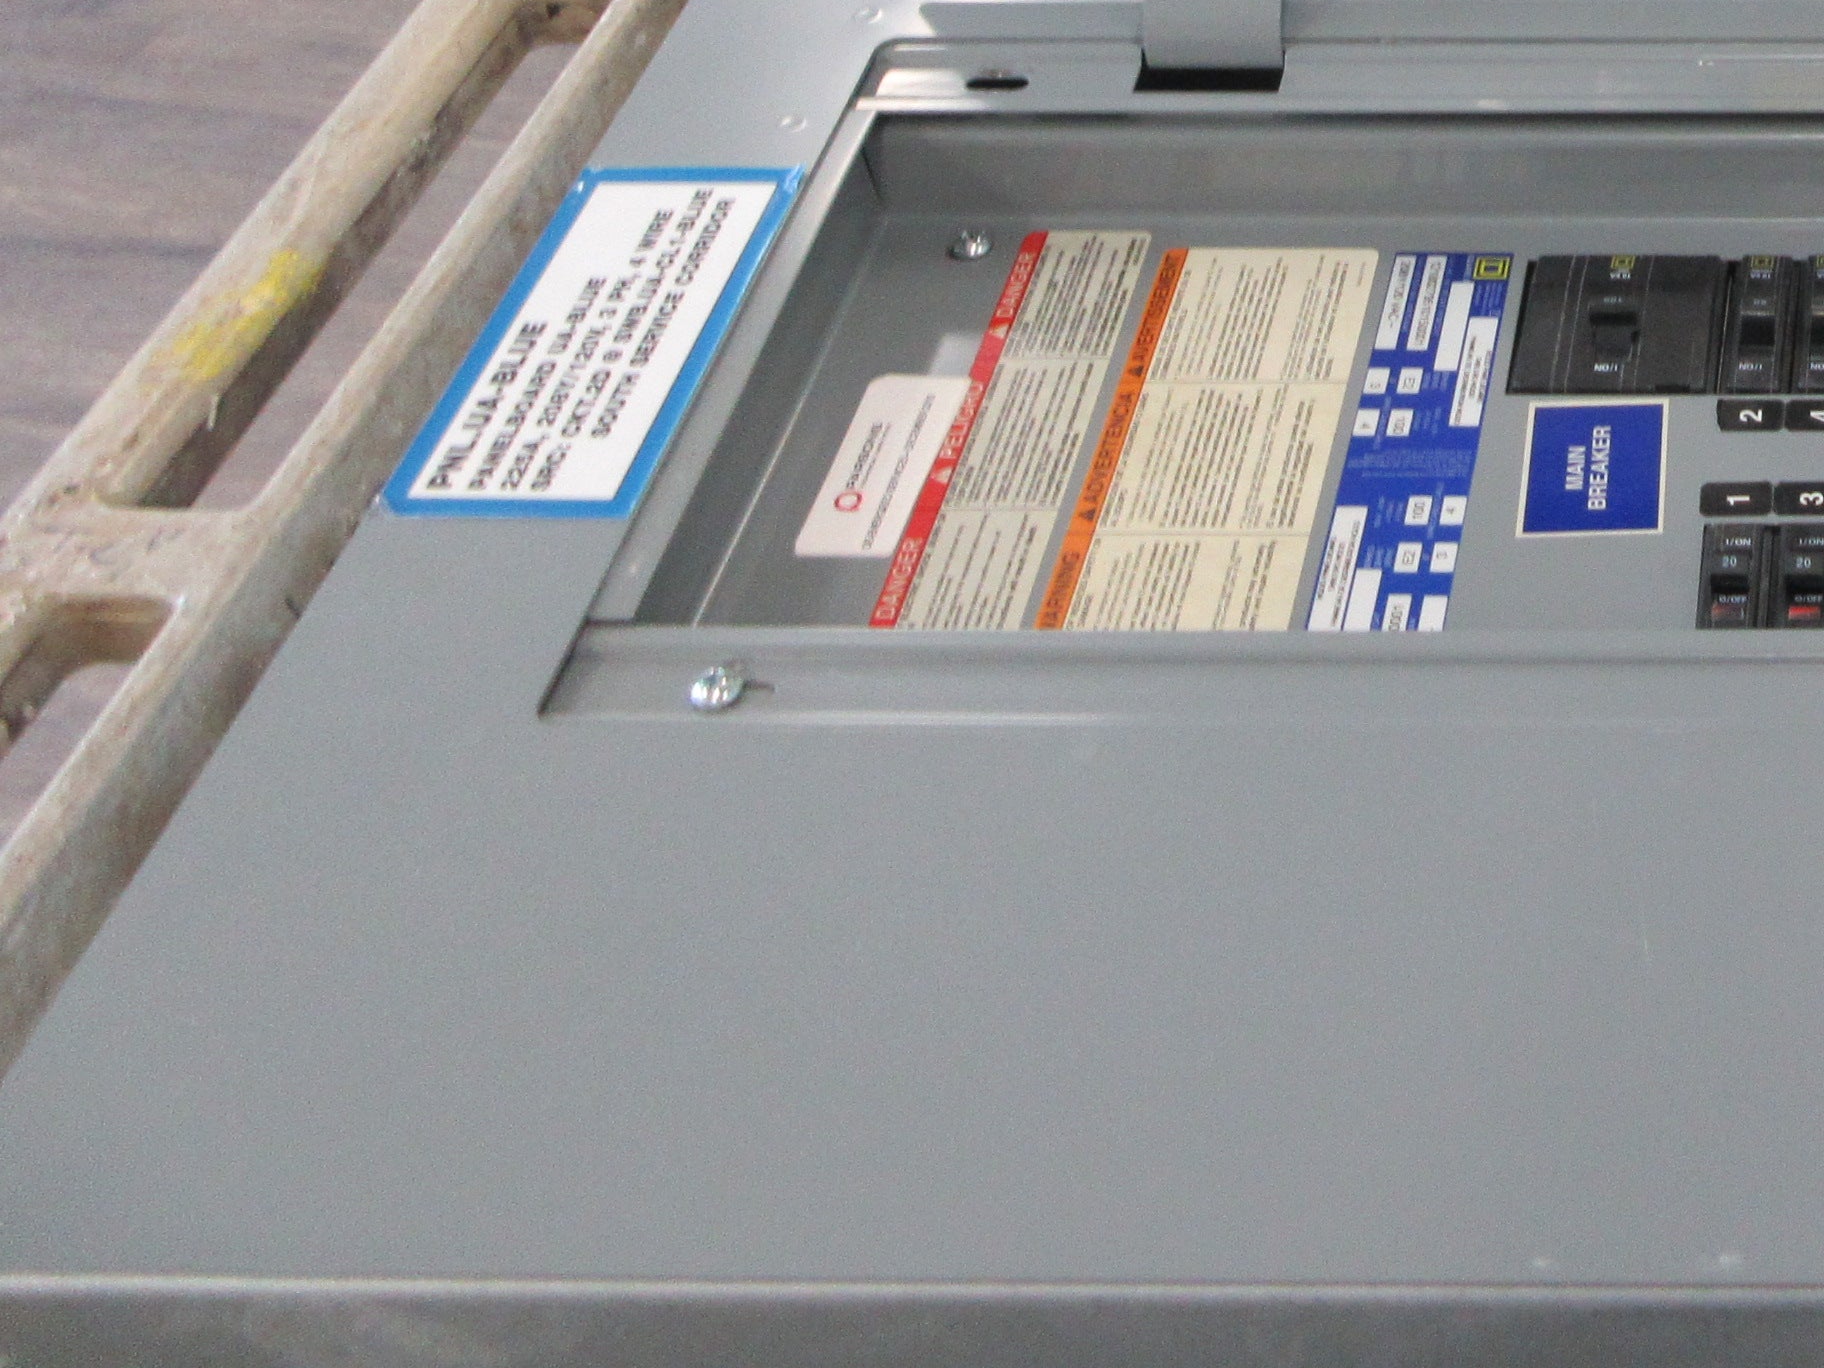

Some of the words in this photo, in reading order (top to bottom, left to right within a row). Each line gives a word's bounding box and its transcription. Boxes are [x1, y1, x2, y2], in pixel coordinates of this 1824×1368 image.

[635, 209, 674, 252] WIRE
[628, 256, 646, 268] 4
[589, 372, 640, 438] SOUTH
[628, 291, 685, 367] SERVICE
[674, 197, 736, 286] CORRIDOR
[466, 361, 557, 489] PANELBOARD
[546, 278, 607, 355] UA-BLUE
[1083, 392, 1133, 503] ADVERTENCIA
[1131, 254, 1176, 361] AVERTISSEMENT
[425, 322, 548, 489] PNL.UA-BLUE
[1739, 409, 1763, 423] 2
[875, 538, 920, 620] DANGER
[939, 382, 984, 460] PELIGRO
[992, 252, 1032, 318] DANGER
[1565, 445, 1586, 490] MAIN
[1587, 425, 1611, 510] BREAKER
[1726, 495, 1751, 506] 1
[1799, 491, 1824, 506] 3
[1721, 556, 1737, 568] 20
[1796, 557, 1812, 569] 20
